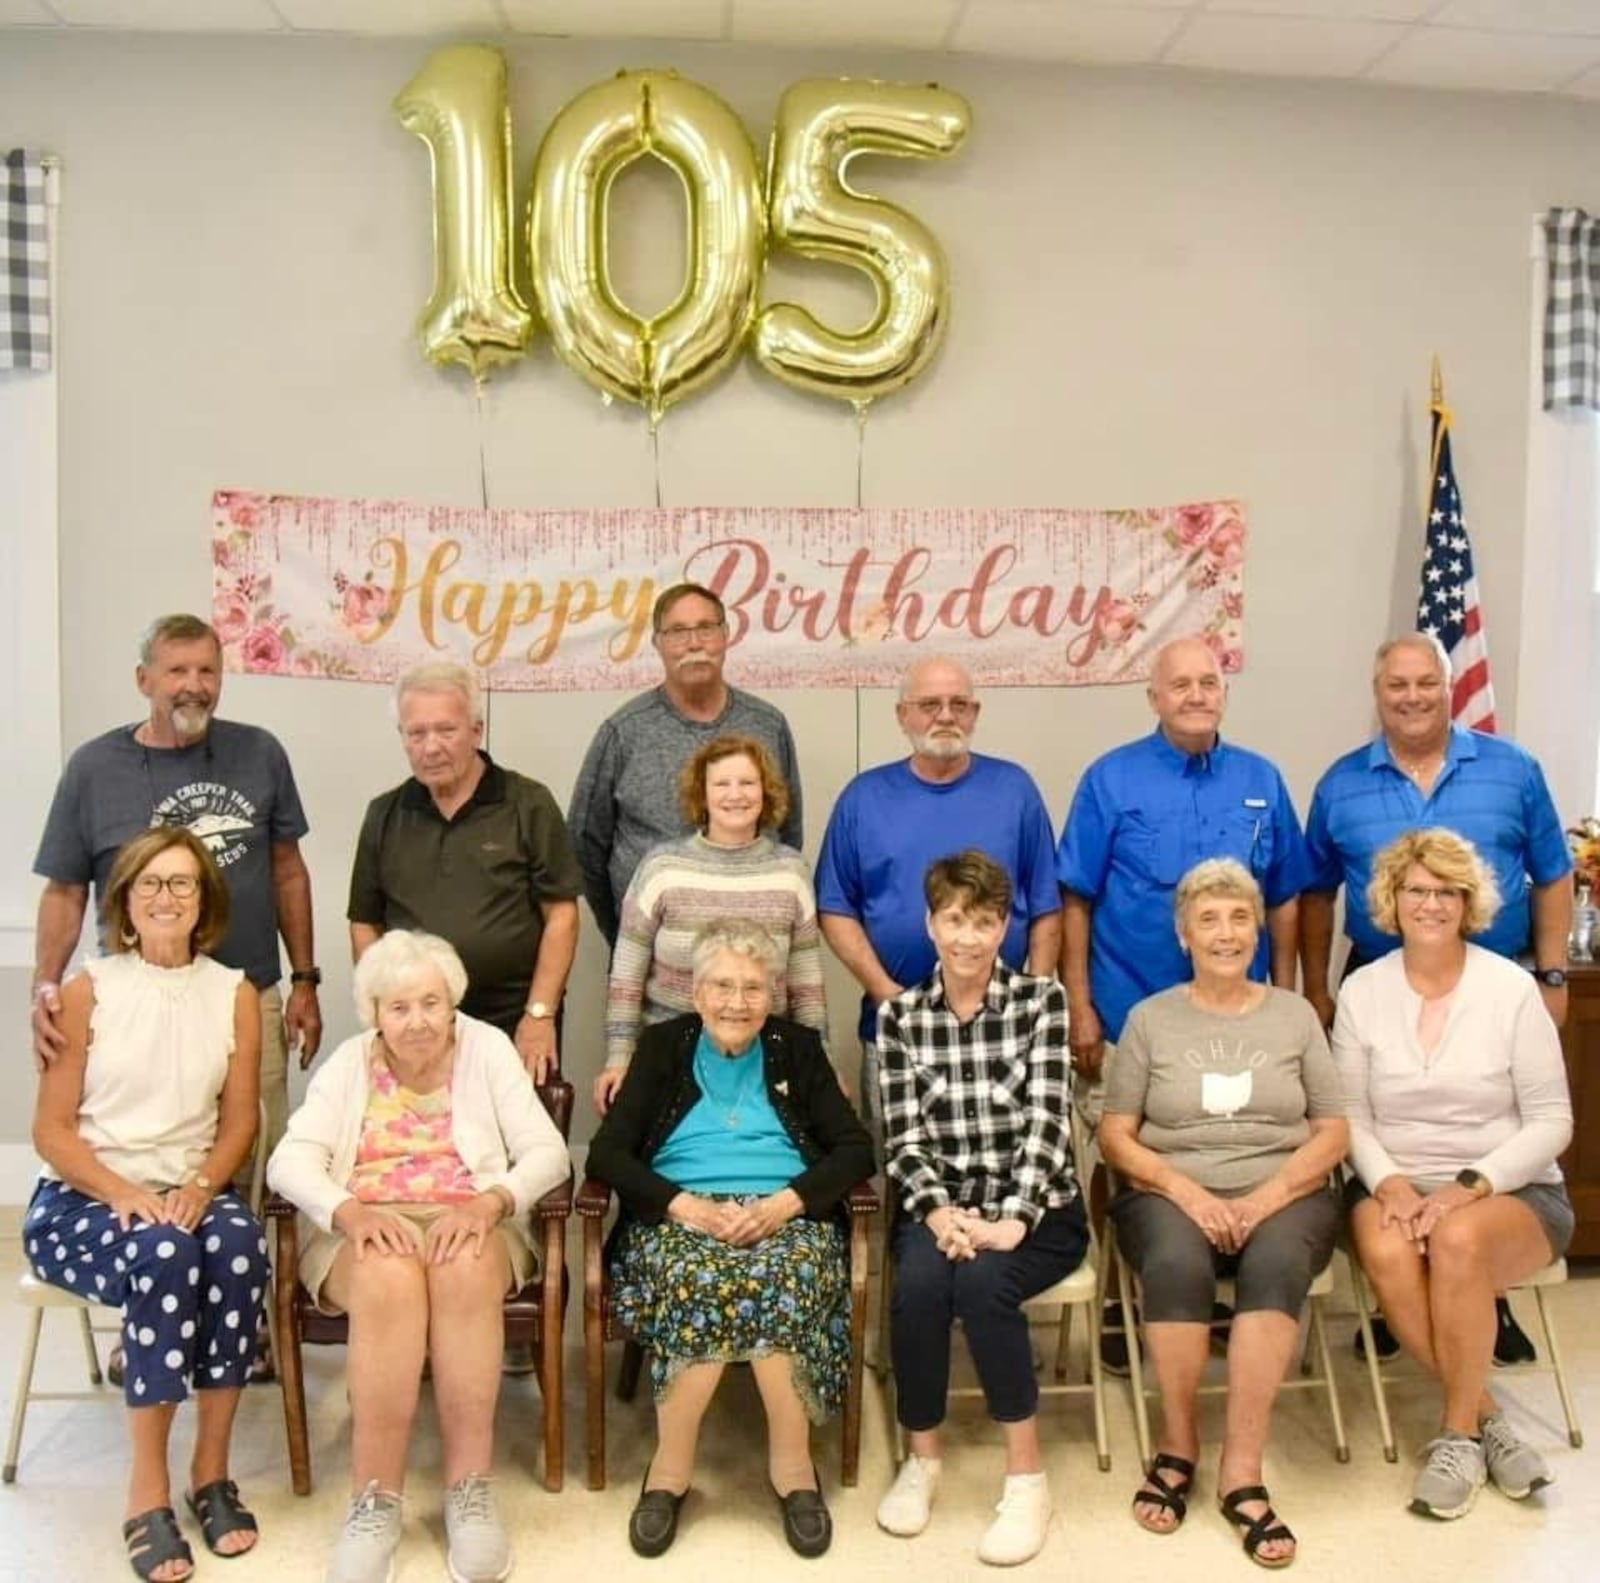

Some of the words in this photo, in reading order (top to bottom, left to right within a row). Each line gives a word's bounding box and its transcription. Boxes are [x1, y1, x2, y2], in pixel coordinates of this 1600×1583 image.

[395, 42, 972, 406] 105
[358, 537, 656, 668] Happy
[683, 538, 1112, 668] Birthday
[1184, 1039, 1268, 1069] OHIO
